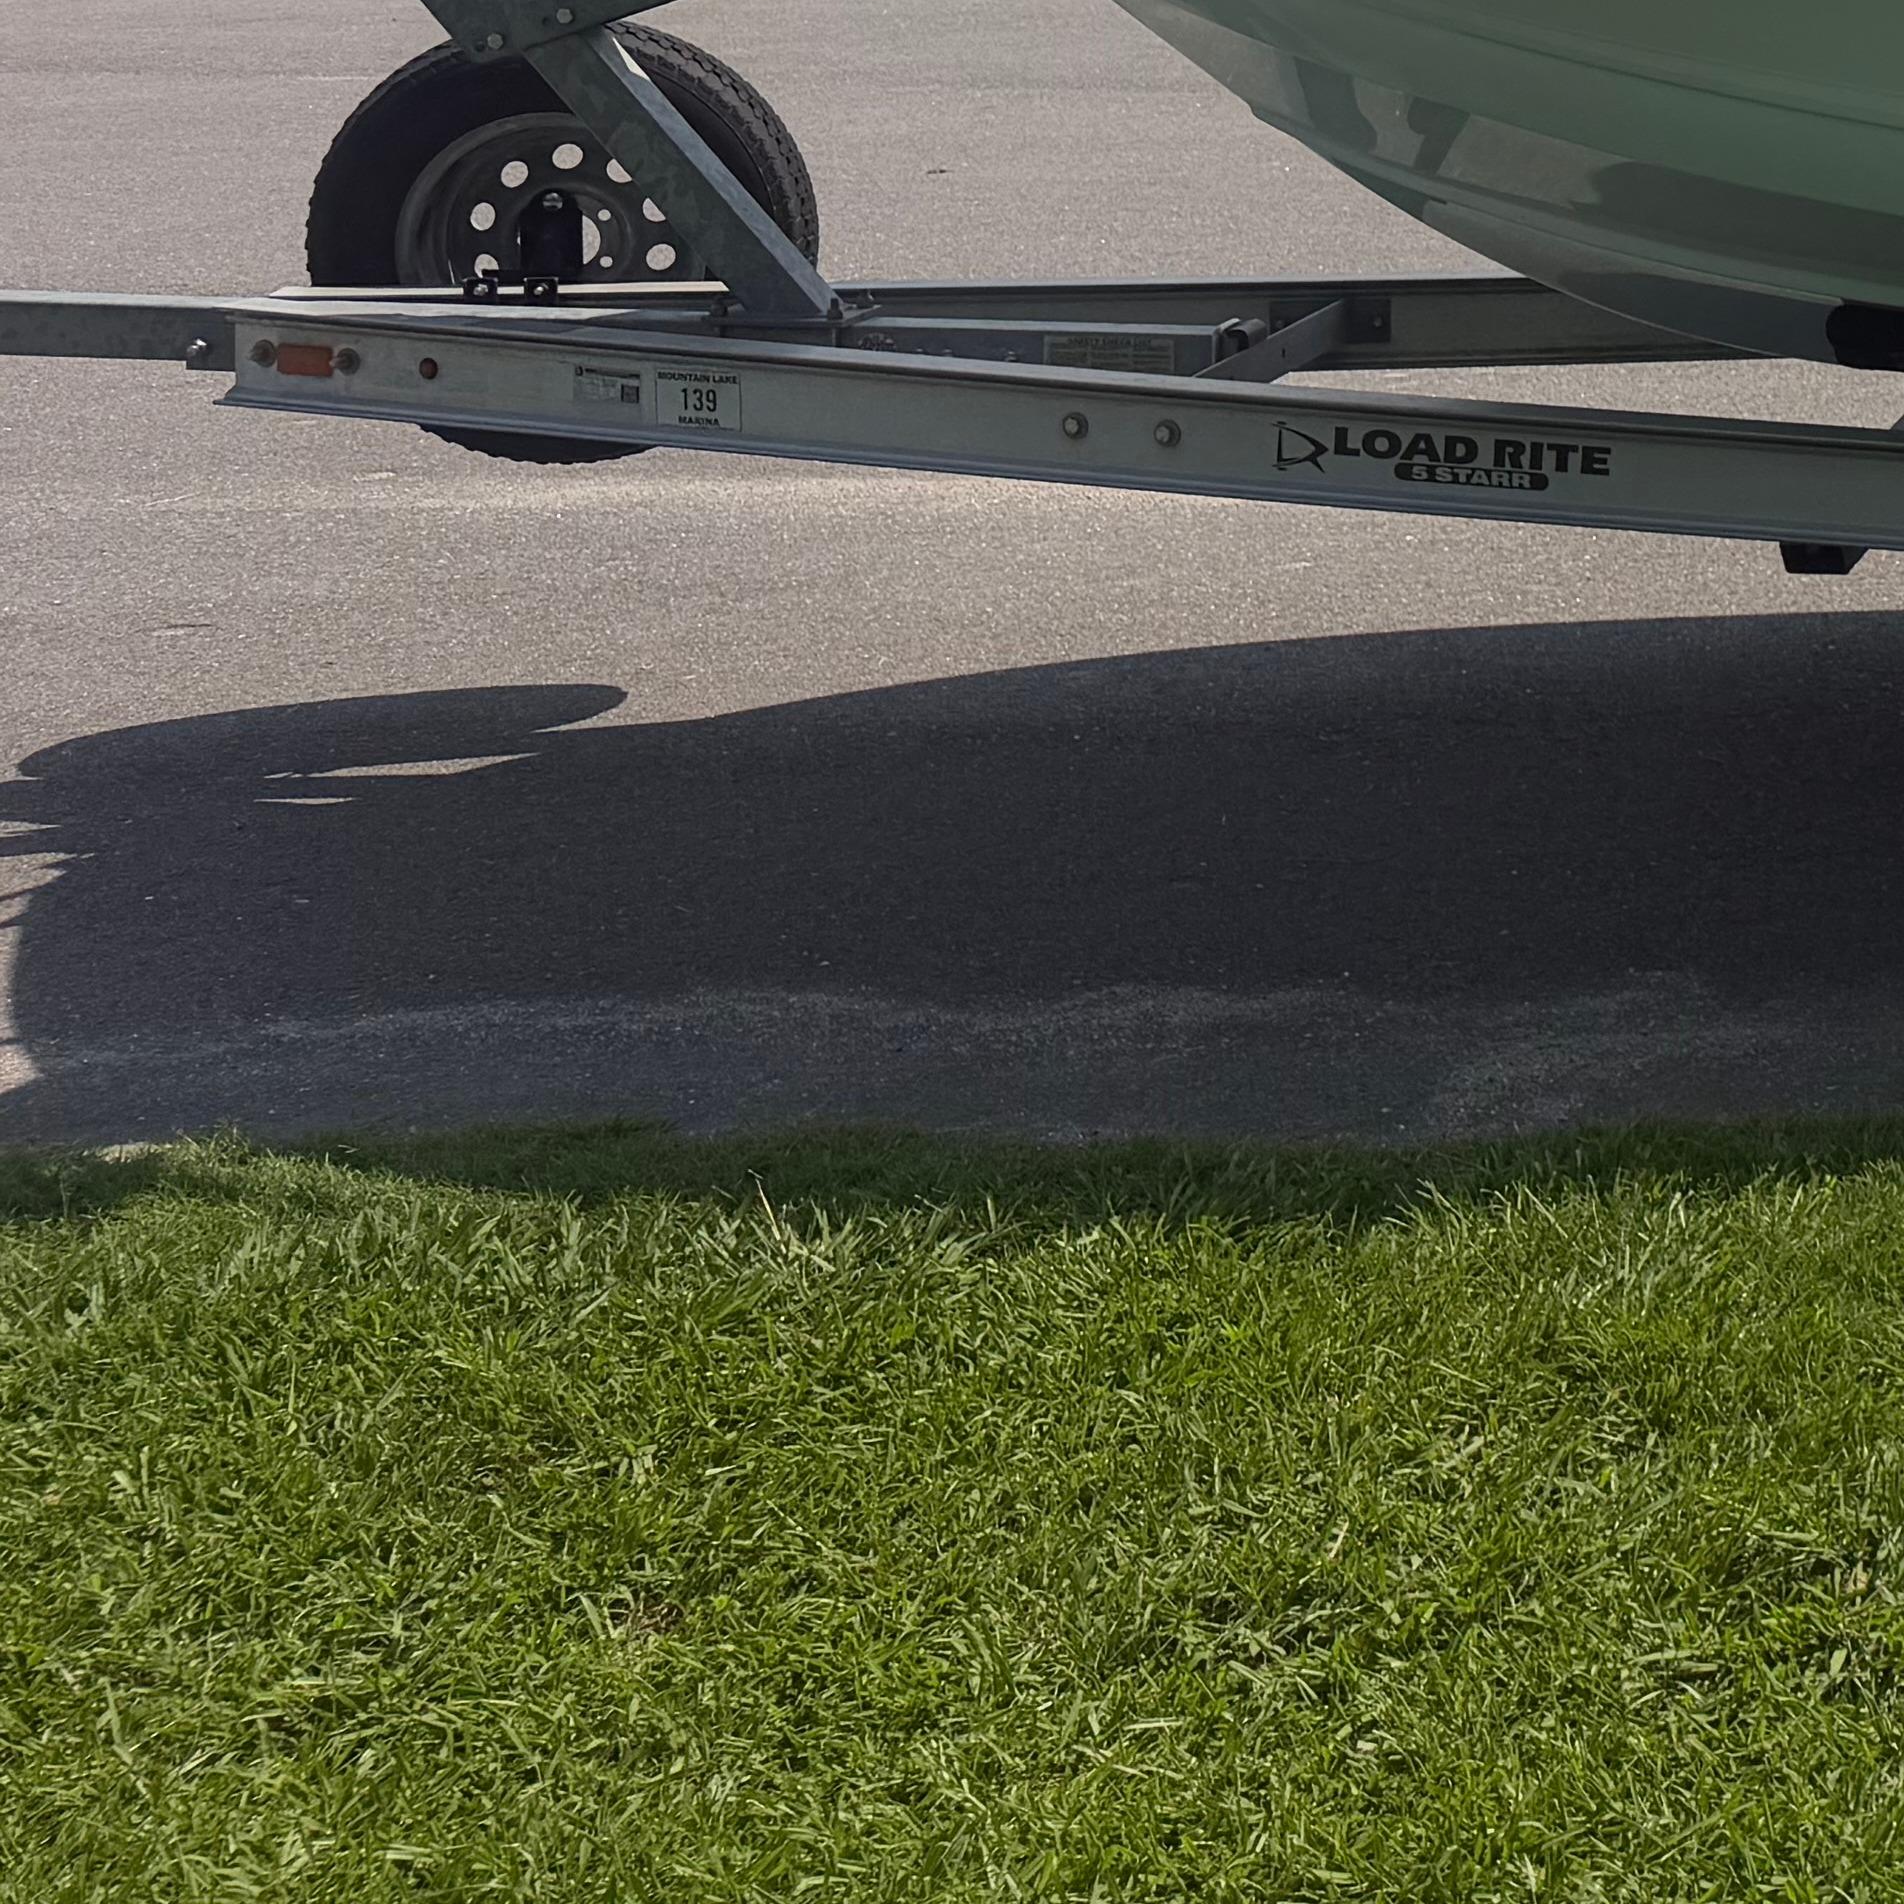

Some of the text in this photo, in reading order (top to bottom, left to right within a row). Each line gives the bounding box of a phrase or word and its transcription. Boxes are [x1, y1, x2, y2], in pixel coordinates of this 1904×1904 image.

[657, 370, 739, 386] MOUNTAIN LAKE
[680, 387, 718, 413] 139
[677, 415, 721, 427] MARINA
[1333, 425, 1612, 477] LOAD RITE
[1411, 465, 1532, 490] 5 STARR
